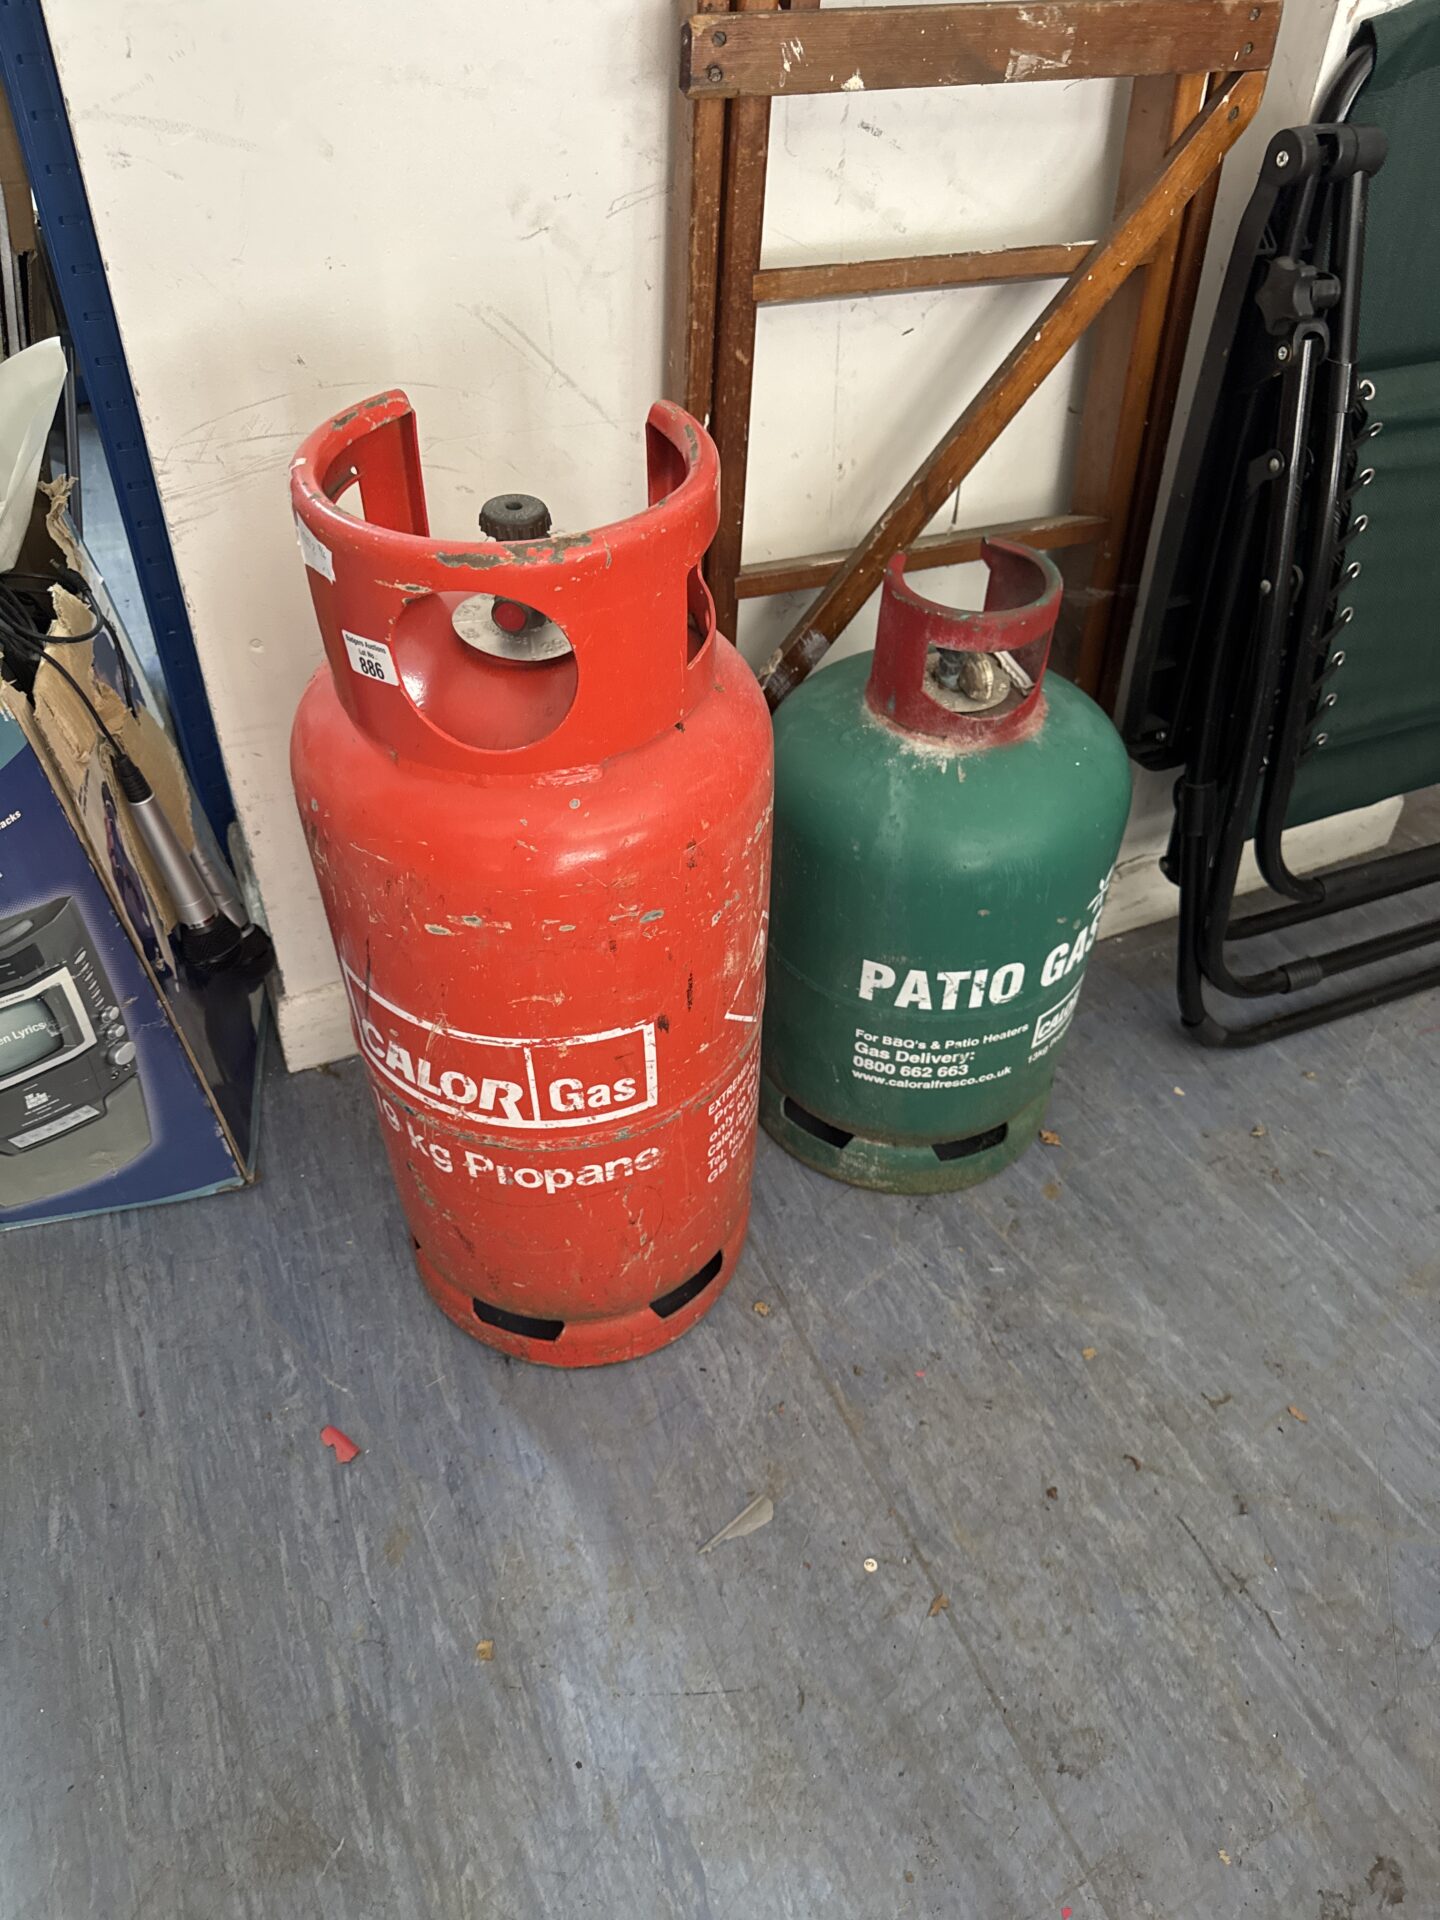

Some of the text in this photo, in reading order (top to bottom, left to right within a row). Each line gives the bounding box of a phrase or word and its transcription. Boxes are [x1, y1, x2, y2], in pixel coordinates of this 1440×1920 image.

[359, 656, 385, 680] 886
[0, 810, 22, 831] acks
[858, 958, 1026, 1011] PATIO
[12, 1021, 47, 1040] Lyrics
[854, 1023, 1030, 1050] For BBQ's & Patio Heaters
[854, 1041, 976, 1065] Gas Delivery:
[361, 1018, 524, 1122] CALOR
[548, 1075, 637, 1114] Gas
[851, 1066, 1013, 1090] www.caloralfresco.co.uk
[853, 1055, 969, 1078] 0800 662 663
[707, 1126, 735, 1158] Calor
[405, 1120, 454, 1174] kg
[463, 1147, 662, 1194] Propane
[707, 1149, 727, 1170] Tel.
[707, 1159, 728, 1183] GB
